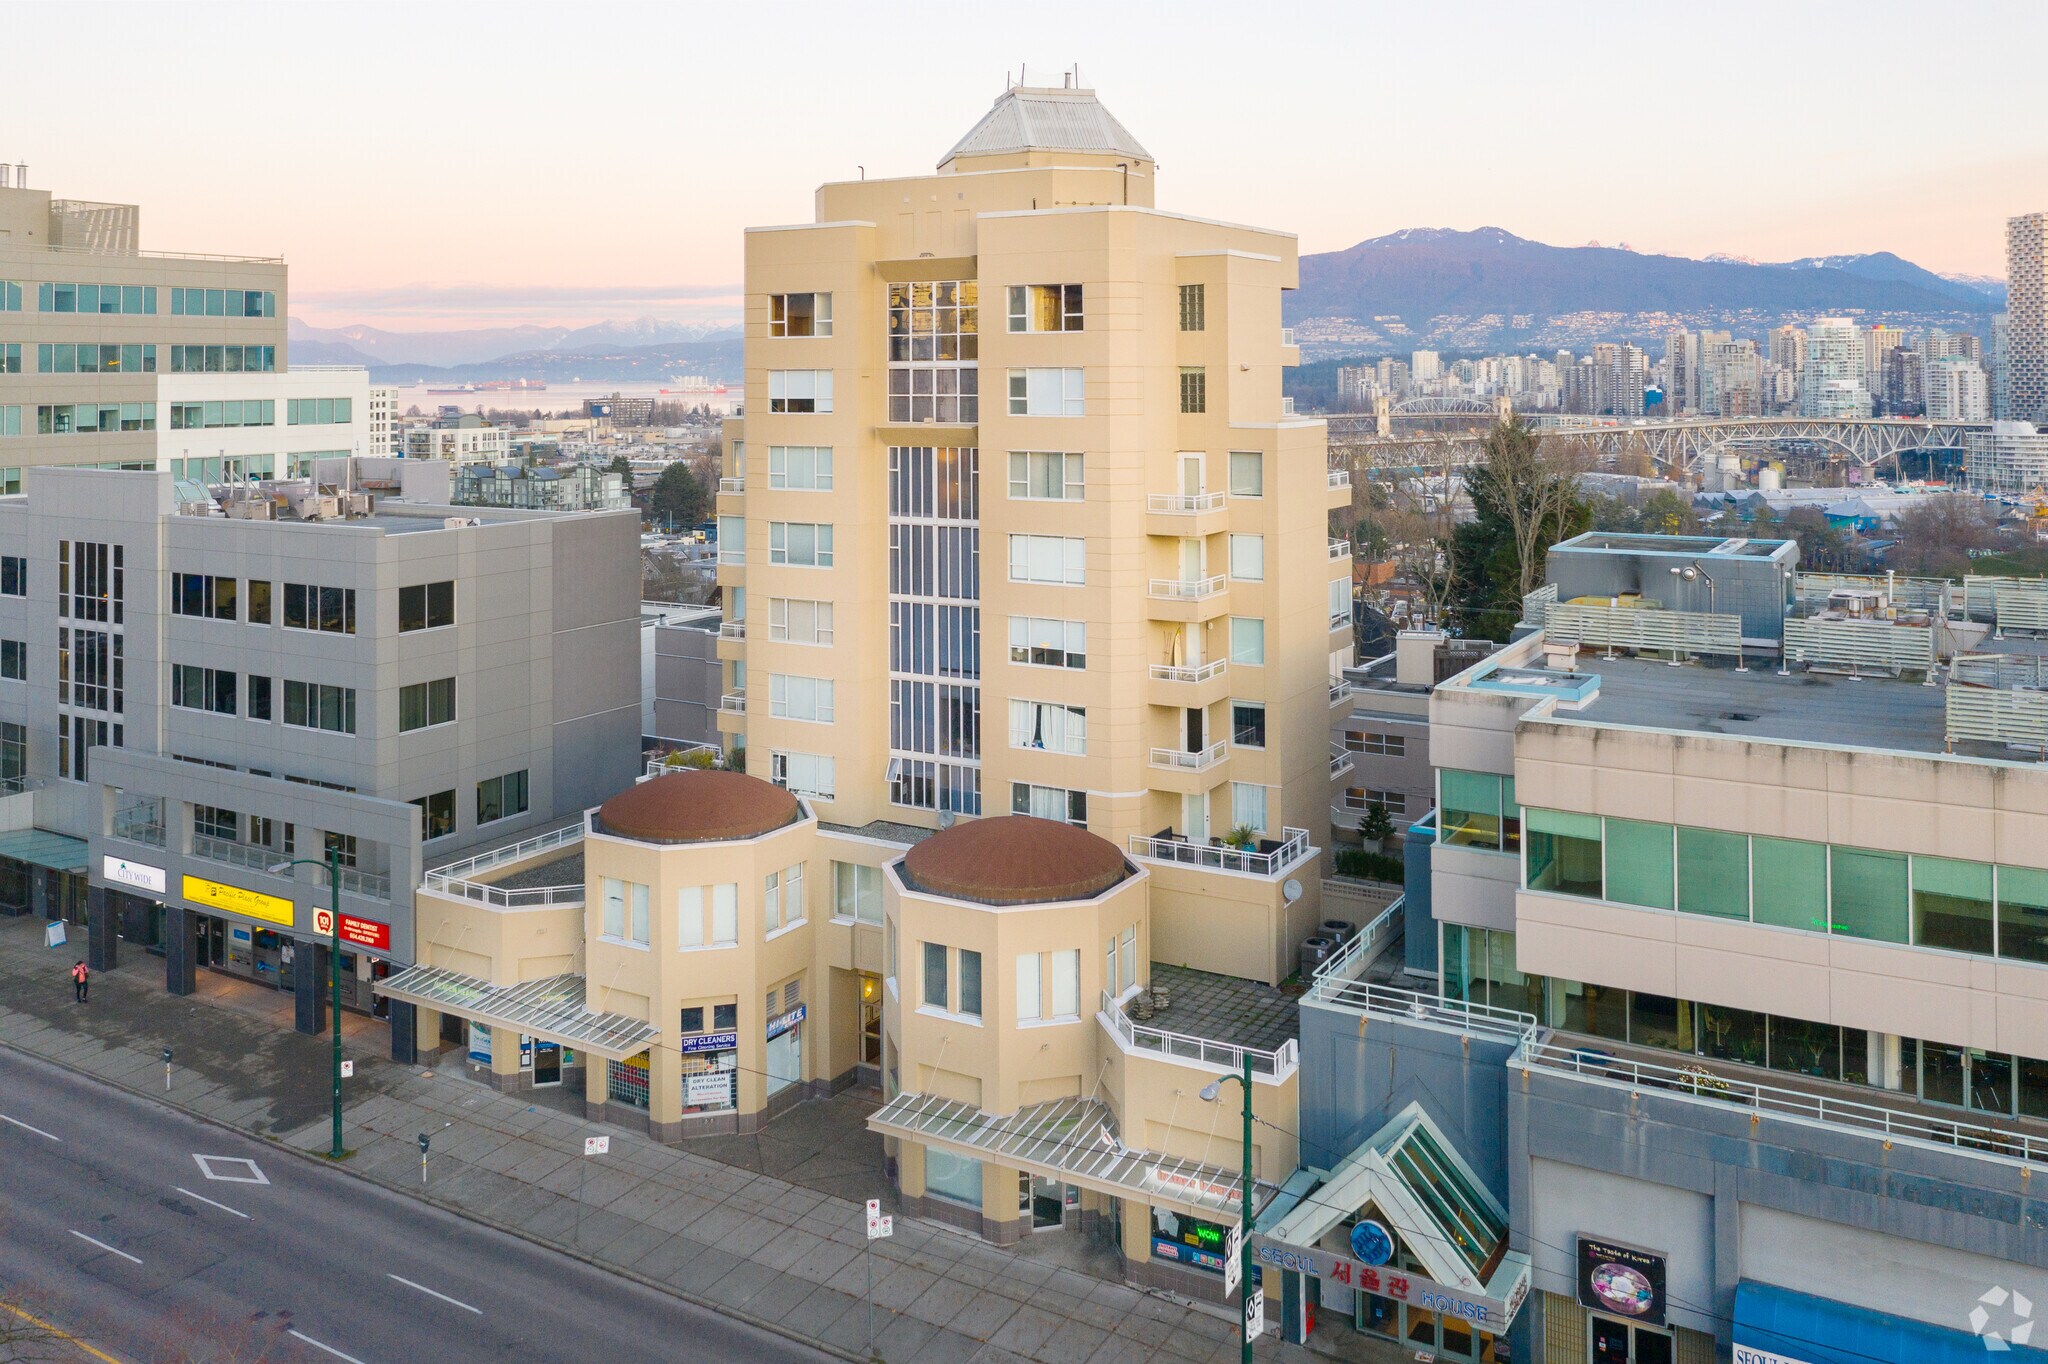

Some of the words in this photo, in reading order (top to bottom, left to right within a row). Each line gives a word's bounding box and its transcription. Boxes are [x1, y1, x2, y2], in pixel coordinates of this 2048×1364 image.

[118, 868, 133, 880] CITY
[134, 871, 152, 885] WIDE
[218, 886, 237, 898] Pacific
[238, 891, 252, 902] Place
[254, 896, 270, 908] Group
[319, 915, 329, 926] 101
[345, 918, 360, 928] FAMILY
[360, 922, 378, 932] DENTIST
[769, 1007, 803, 1032] HI-LITE
[683, 1038, 698, 1047] DRY
[698, 1034, 736, 1045] CLEANERS
[691, 1083, 728, 1091] ALTERATION
[1197, 1228, 1220, 1242] WOW
[1260, 1246, 1319, 1276] SEOUL
[1588, 1244, 1601, 1252] The
[1602, 1247, 1622, 1257] Taste
[1631, 1255, 1651, 1264] Korea
[1330, 1260, 1410, 1300] 서울관
[1421, 1289, 1488, 1322] HOUSE
